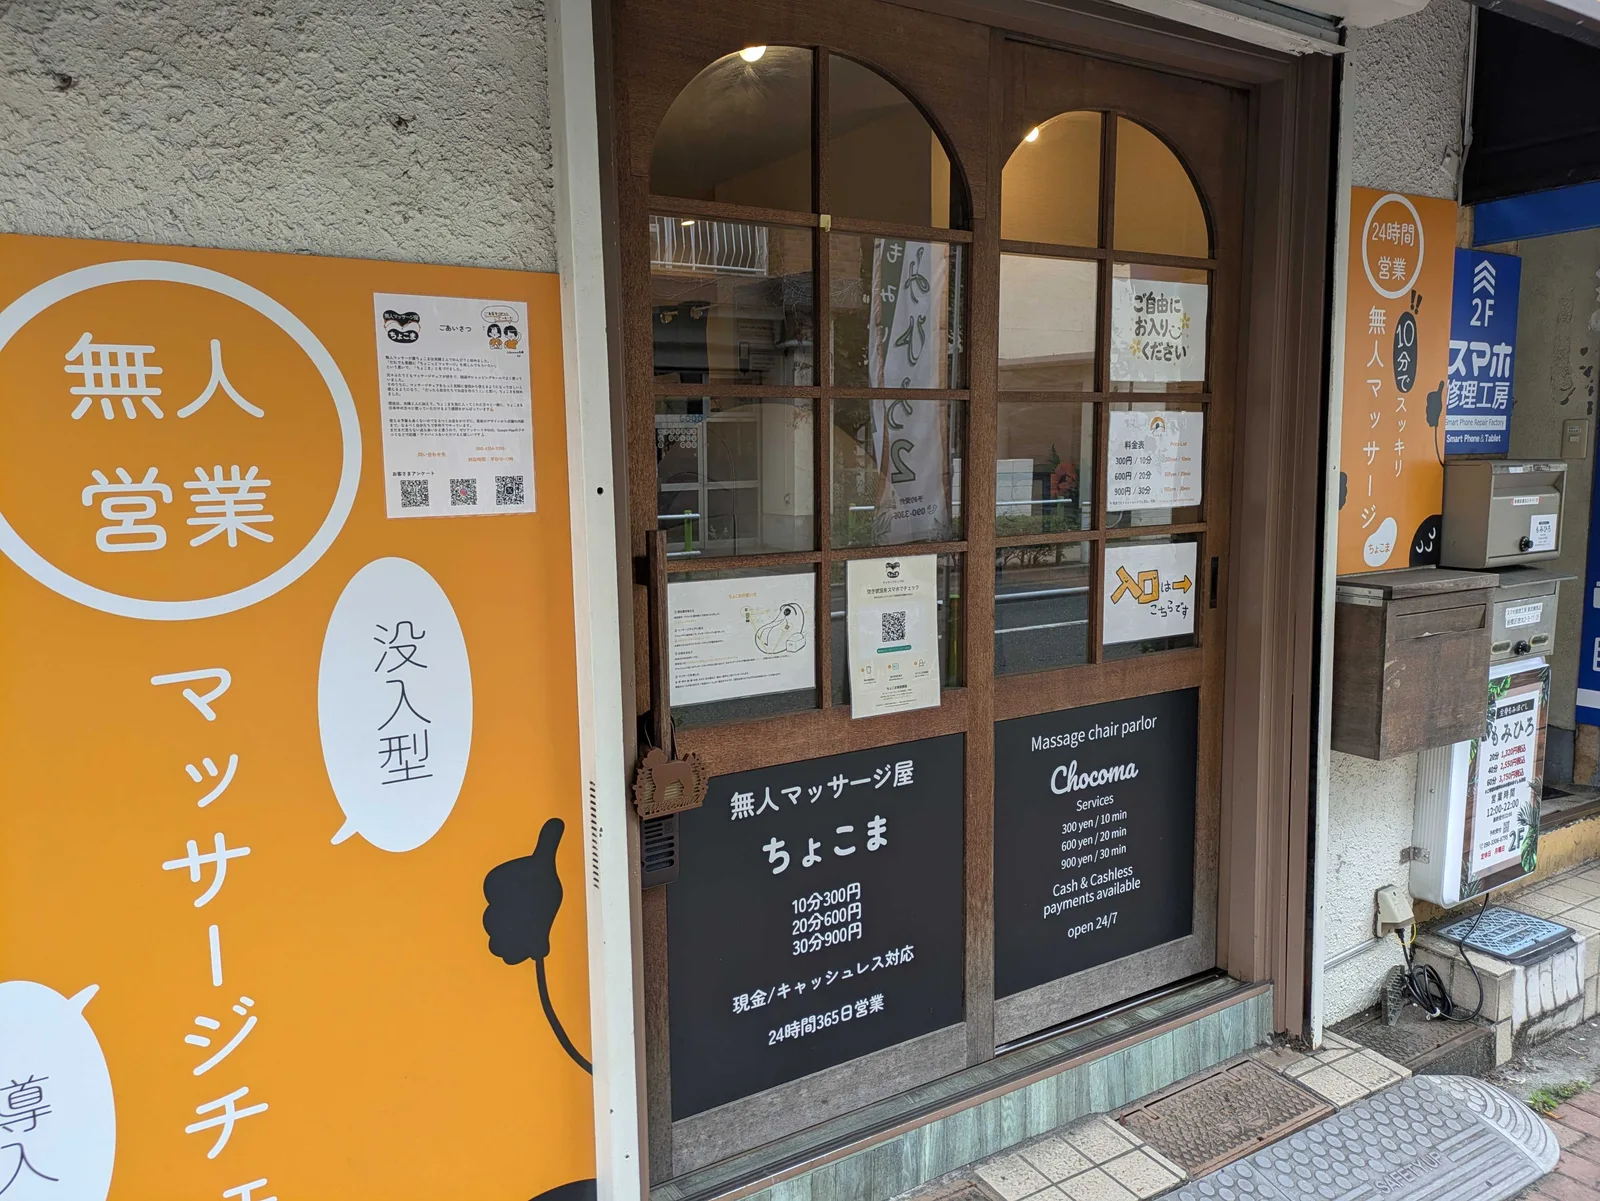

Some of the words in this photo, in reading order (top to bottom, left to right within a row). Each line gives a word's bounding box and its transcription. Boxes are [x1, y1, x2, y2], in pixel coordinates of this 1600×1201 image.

[1372, 221, 1415, 247] 24時間
[1378, 256, 1407, 281] 営業
[1133, 291, 1181, 315] ご自由に
[1470, 298, 1495, 327] 2F
[388, 331, 418, 341] ちょこま
[438, 324, 472, 333] ごあいさつ
[1134, 316, 1169, 338] お入り
[1141, 341, 1187, 362] ください
[1448, 340, 1513, 378] スマホ
[64, 331, 266, 421] 無人
[1446, 379, 1510, 410] 修理工房
[1361, 305, 1387, 529] 無人マッサージ
[1445, 418, 1459, 426] Smart
[1459, 418, 1473, 426] Phone
[1473, 418, 1488, 428] Repair
[1488, 419, 1505, 428] Factory
[1124, 440, 1145, 450] 料金表
[1446, 434, 1463, 443] Smart
[1464, 434, 1480, 443] Phone
[1484, 434, 1501, 443] Tablet
[1115, 456, 1133, 466] 300円
[1139, 455, 1153, 465] 10分
[1114, 471, 1132, 481] 600円
[1139, 470, 1152, 480] 20分
[1114, 486, 1132, 497] 900円
[1137, 485, 1152, 495] 30分
[81, 464, 275, 553] 営業
[1368, 542, 1391, 555] ちょこま
[1150, 600, 1189, 620] こちらです
[373, 619, 433, 786] 没入型
[1031, 728, 1086, 752] Massage
[1088, 721, 1119, 741] chair
[1121, 715, 1158, 738] parlor
[730, 760, 914, 821] 無人マッサージ屋
[1050, 760, 1139, 795] Chocoma
[1076, 794, 1114, 812] Services
[1486, 798, 1520, 818] 12:00-22:00
[1490, 787, 1516, 805] 営業時間
[1061, 821, 1077, 835] 300
[1077, 819, 1094, 832] yen
[1100, 813, 1111, 826] 10
[1111, 810, 1128, 822] min
[762, 814, 888, 875] ちょこま
[1061, 838, 1077, 852] 600
[1077, 836, 1093, 850] yen
[1099, 830, 1110, 843] 20
[1111, 827, 1127, 839] min
[1508, 827, 1526, 853] 2F
[1061, 856, 1077, 870] 900
[1077, 853, 1093, 868] yen
[1099, 848, 1110, 860] 30
[1110, 844, 1127, 857] min
[1052, 877, 1078, 897] Cash
[1080, 876, 1088, 889] &
[1090, 865, 1134, 887] Cashless
[792, 882, 861, 915] 10分300円
[1043, 890, 1095, 919] payments
[1096, 877, 1141, 901] available
[792, 902, 862, 936] 20分600円
[1067, 921, 1094, 940] open
[1095, 911, 1119, 931] 24/7
[792, 921, 863, 956] 30分900円
[732, 944, 915, 1015] 現金/キャッシュレス対応
[768, 993, 885, 1046] 24時間365日営業
[1374, 1157, 1428, 1195] SAFETY
[1420, 1151, 1443, 1171] UP
